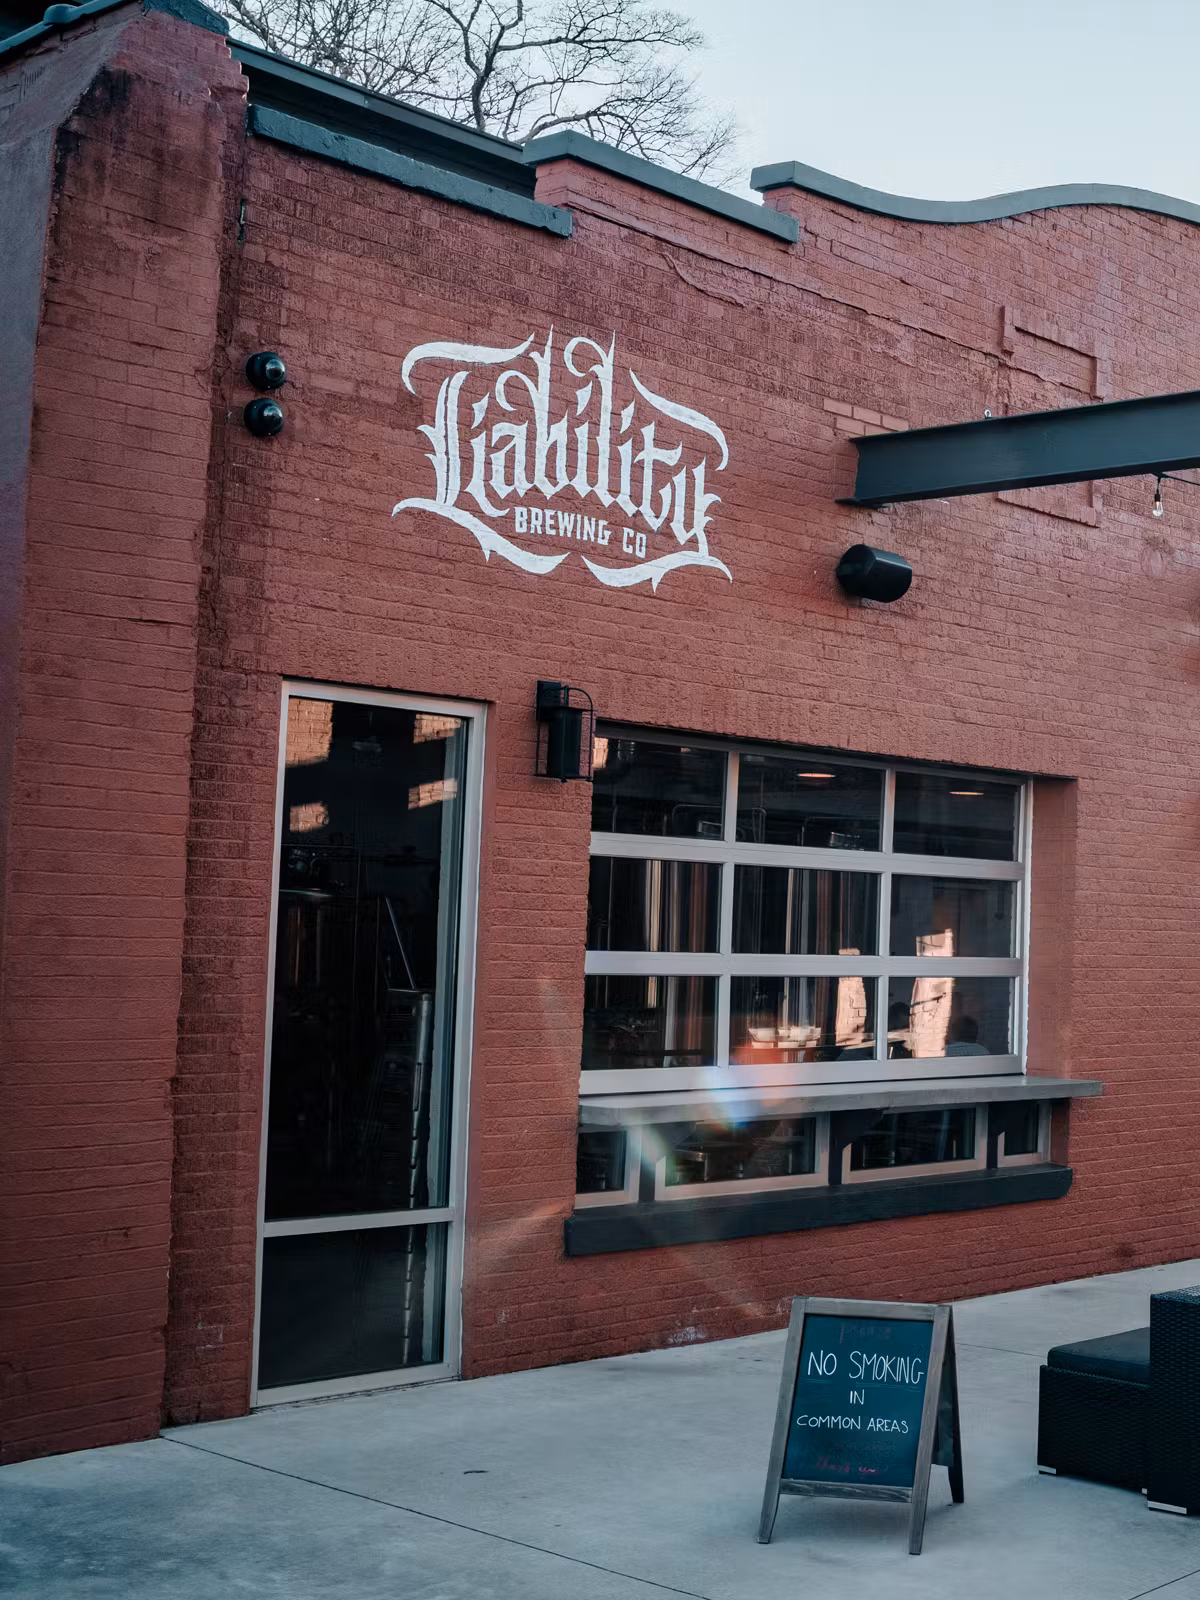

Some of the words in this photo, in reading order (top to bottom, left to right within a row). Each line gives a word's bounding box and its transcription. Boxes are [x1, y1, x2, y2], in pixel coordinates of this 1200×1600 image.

[514, 506, 613, 546] BREWING
[622, 527, 648, 559] CO
[807, 1349, 838, 1376] NO
[848, 1350, 925, 1385] SMOKING
[849, 1389, 865, 1406] IN
[796, 1414, 861, 1430] COMMON
[866, 1417, 909, 1434] AREAS
